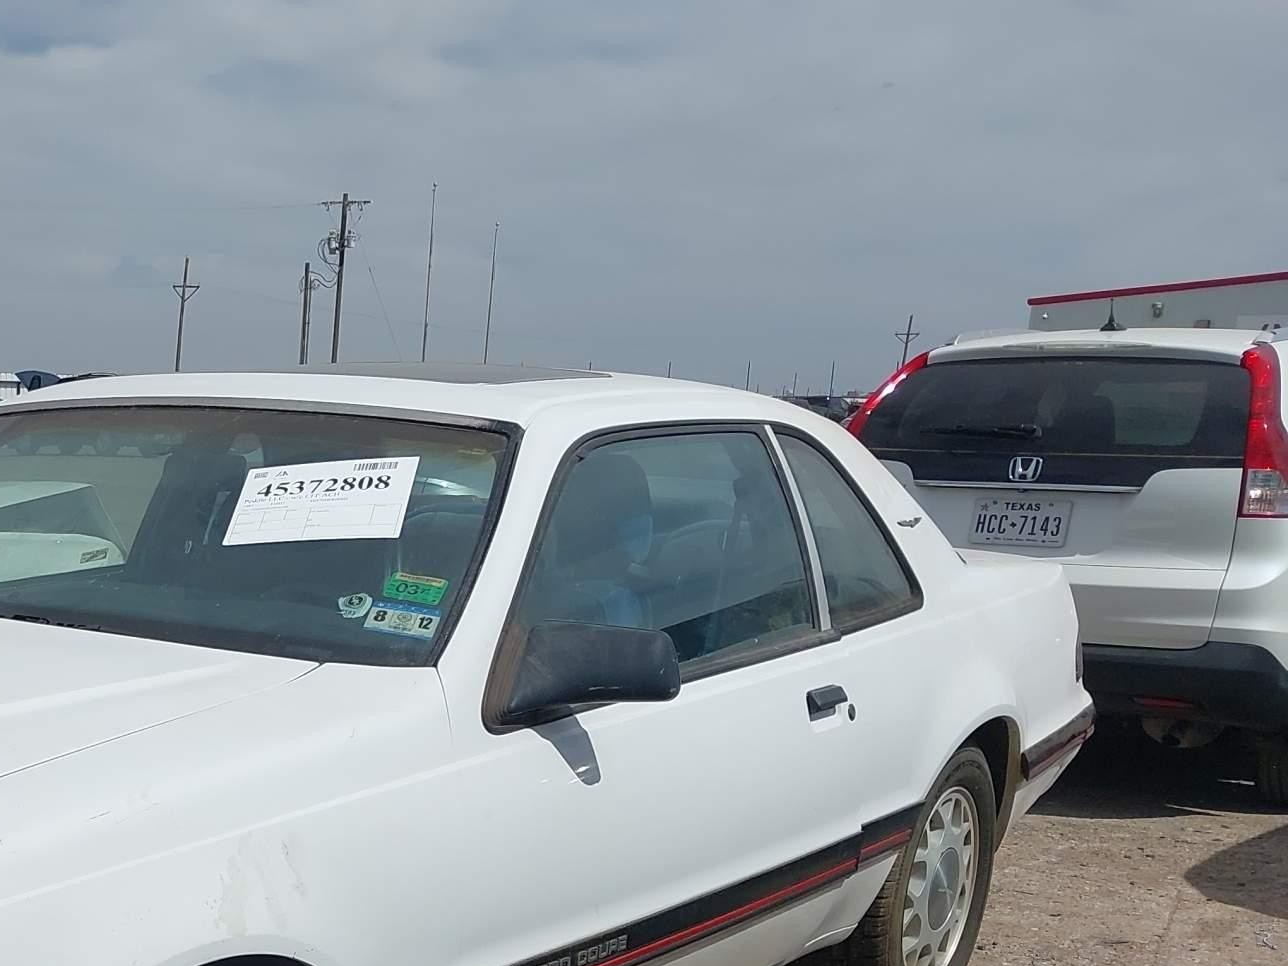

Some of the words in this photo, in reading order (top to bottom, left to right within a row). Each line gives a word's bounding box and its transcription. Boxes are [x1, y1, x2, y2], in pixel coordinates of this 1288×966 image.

[257, 474, 392, 497] 45372808
[1004, 502, 1041, 512] TEXAS
[373, 610, 388, 622] 8
[419, 616, 433, 630] 12
[577, 934, 629, 966] COUPE
